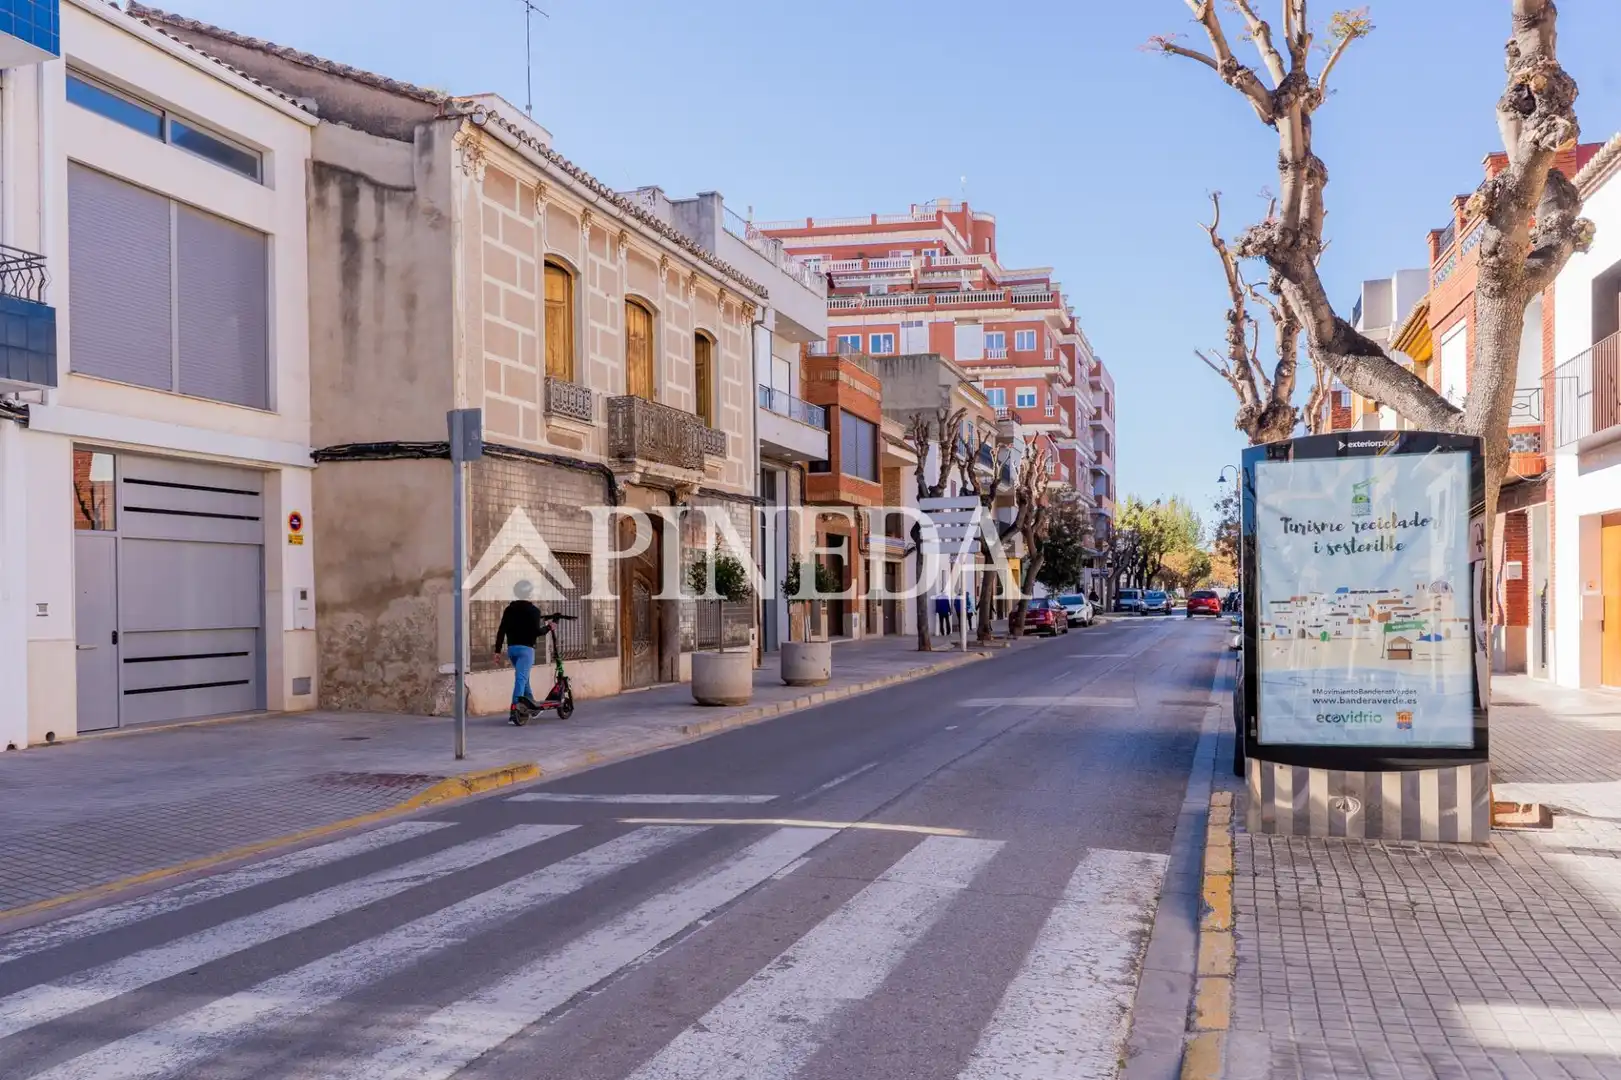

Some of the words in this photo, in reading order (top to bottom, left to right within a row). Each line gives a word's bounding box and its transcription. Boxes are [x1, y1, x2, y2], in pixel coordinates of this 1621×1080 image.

[1348, 440, 1395, 449] exteriorplus
[1280, 516, 1345, 536] Turisme
[1312, 696, 1417, 705] www.banderaverde.es
[1316, 710, 1383, 723] ecovidrio
